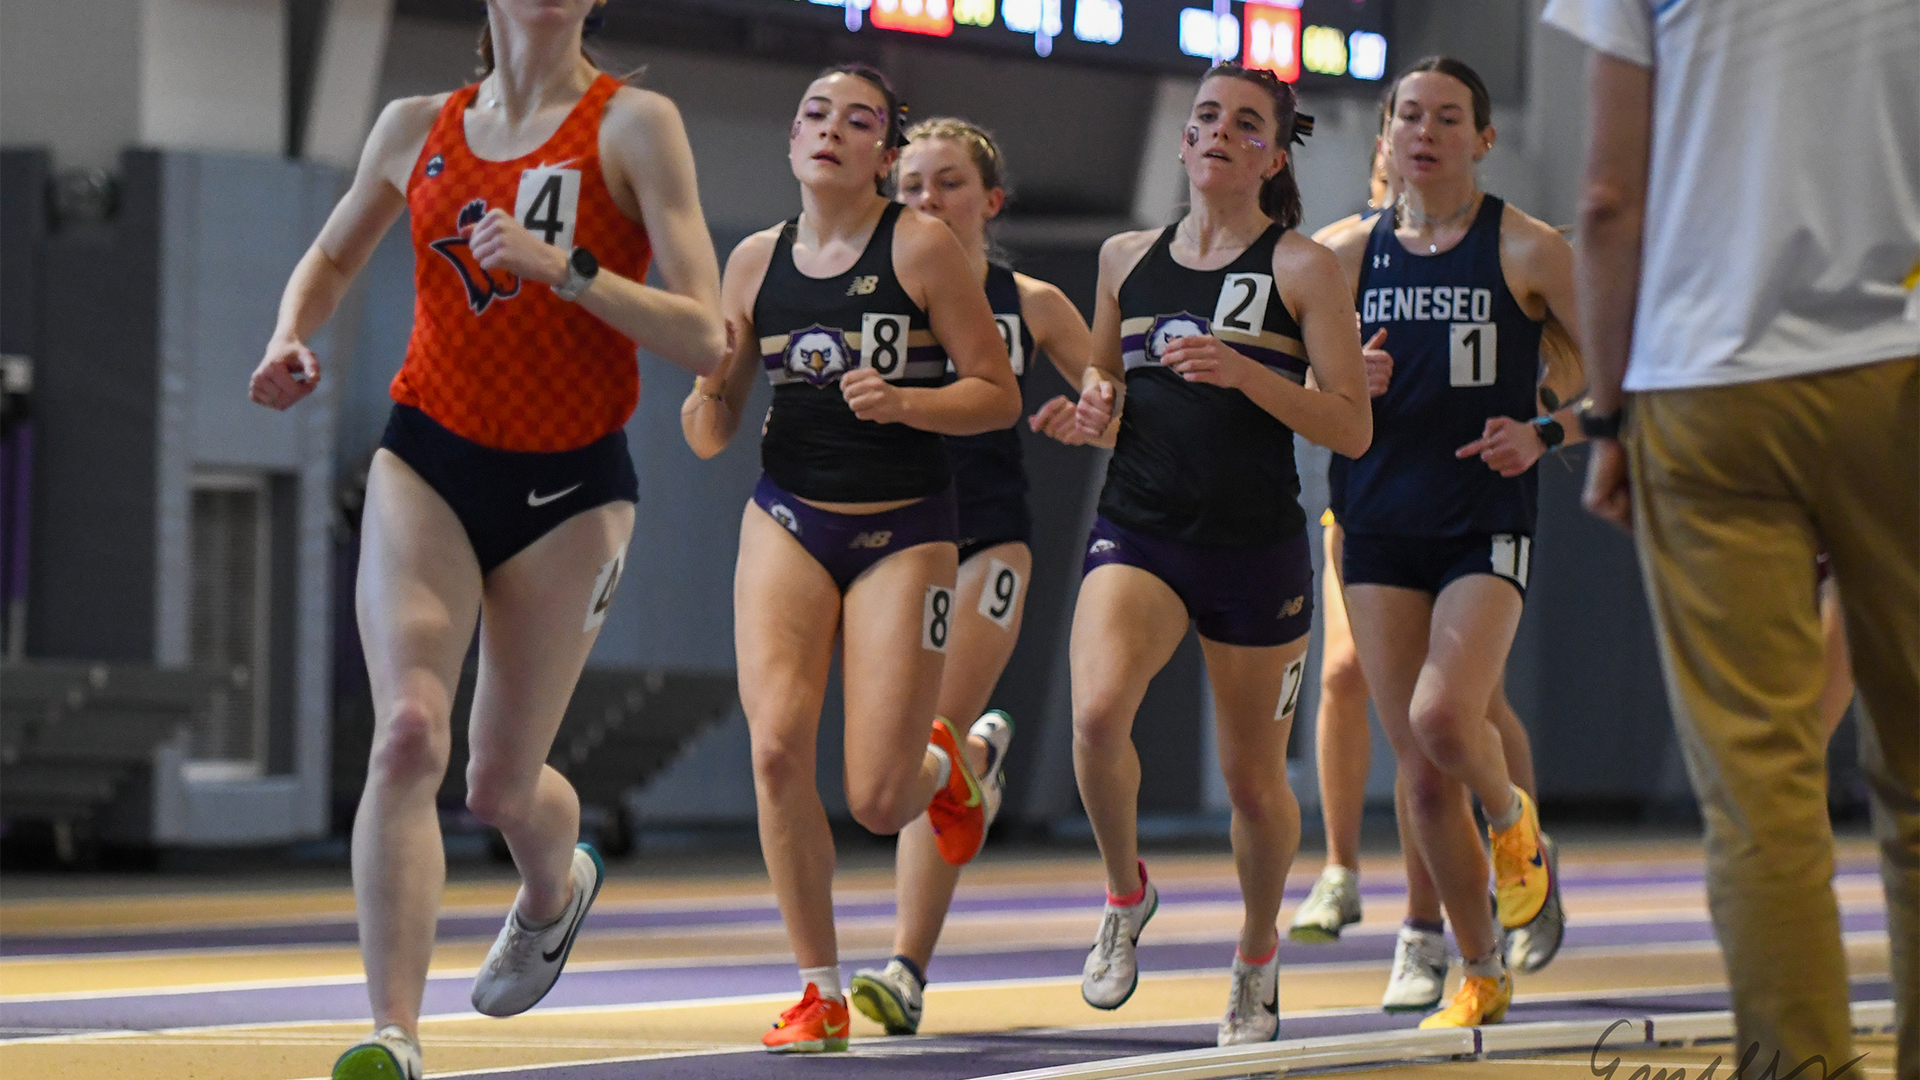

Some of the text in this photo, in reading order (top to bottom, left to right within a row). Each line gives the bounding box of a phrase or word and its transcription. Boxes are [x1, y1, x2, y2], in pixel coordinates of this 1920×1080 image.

[523, 175, 564, 244] 4
[1222, 278, 1258, 331] 2
[1363, 287, 1491, 324] GENESEO
[870, 318, 901, 374] 8
[1461, 328, 1482, 381] 1
[930, 590, 949, 648] 8
[990, 568, 1015, 619] 9
[1282, 661, 1301, 717] 2
